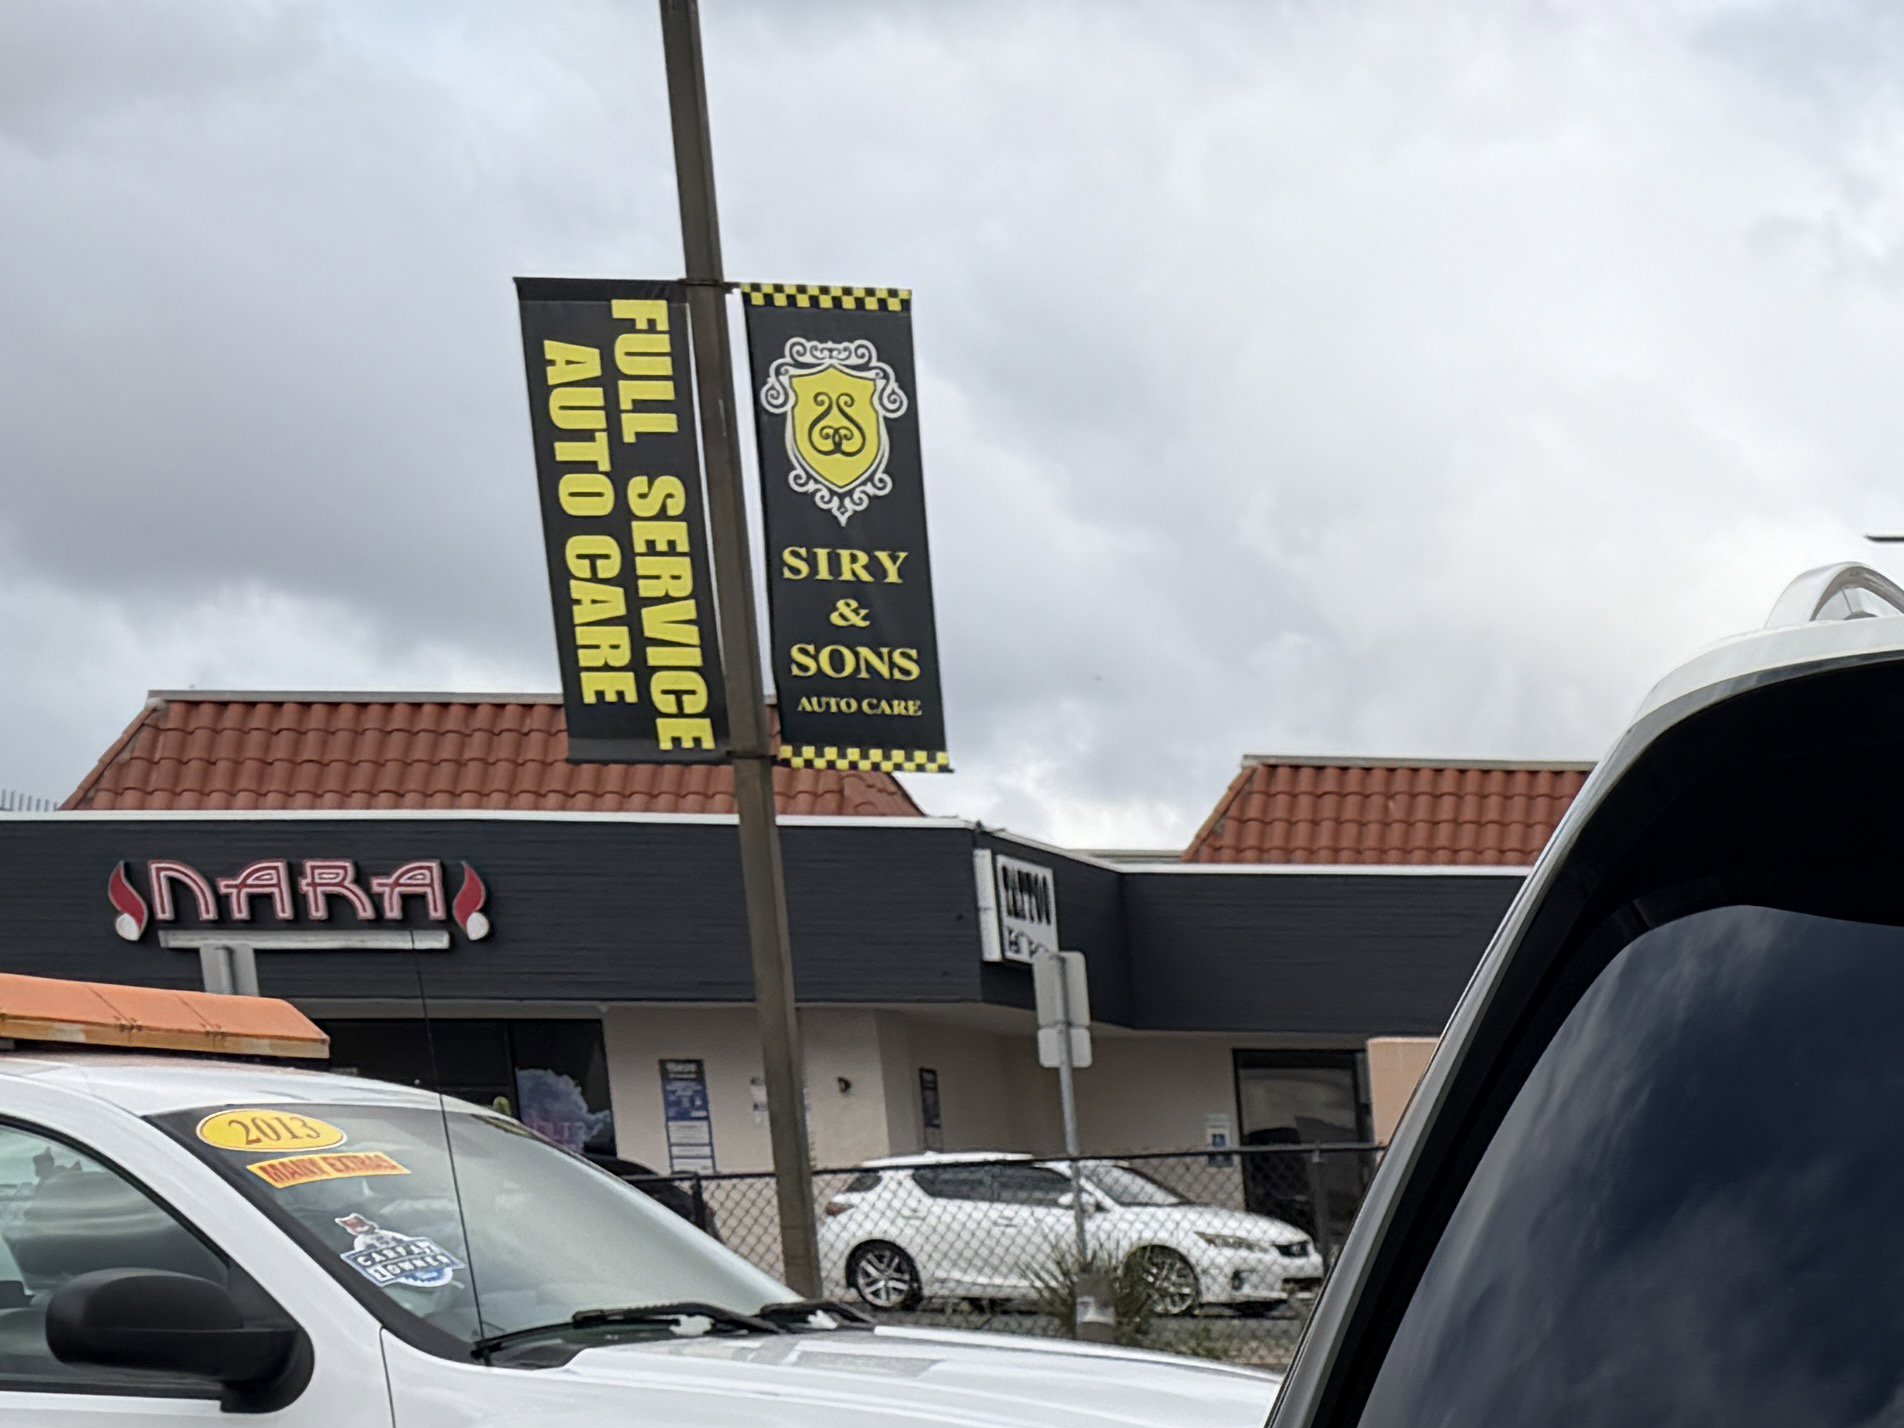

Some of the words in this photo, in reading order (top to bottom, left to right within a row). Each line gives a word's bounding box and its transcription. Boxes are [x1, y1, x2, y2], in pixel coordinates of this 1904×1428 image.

[611, 299, 678, 443] FULL
[543, 339, 614, 516] AUTO
[782, 546, 908, 584] SIRY
[565, 535, 638, 704] CARE
[627, 476, 715, 750] SERVICE
[829, 598, 870, 627] &
[790, 643, 920, 681] SONS
[797, 697, 858, 713] AUTO
[862, 698, 922, 716] CARE
[147, 859, 447, 920] NARA
[228, 1116, 320, 1145] 2013
[258, 1158, 331, 1183] MANY
[319, 1154, 398, 1174] EXTRAS
